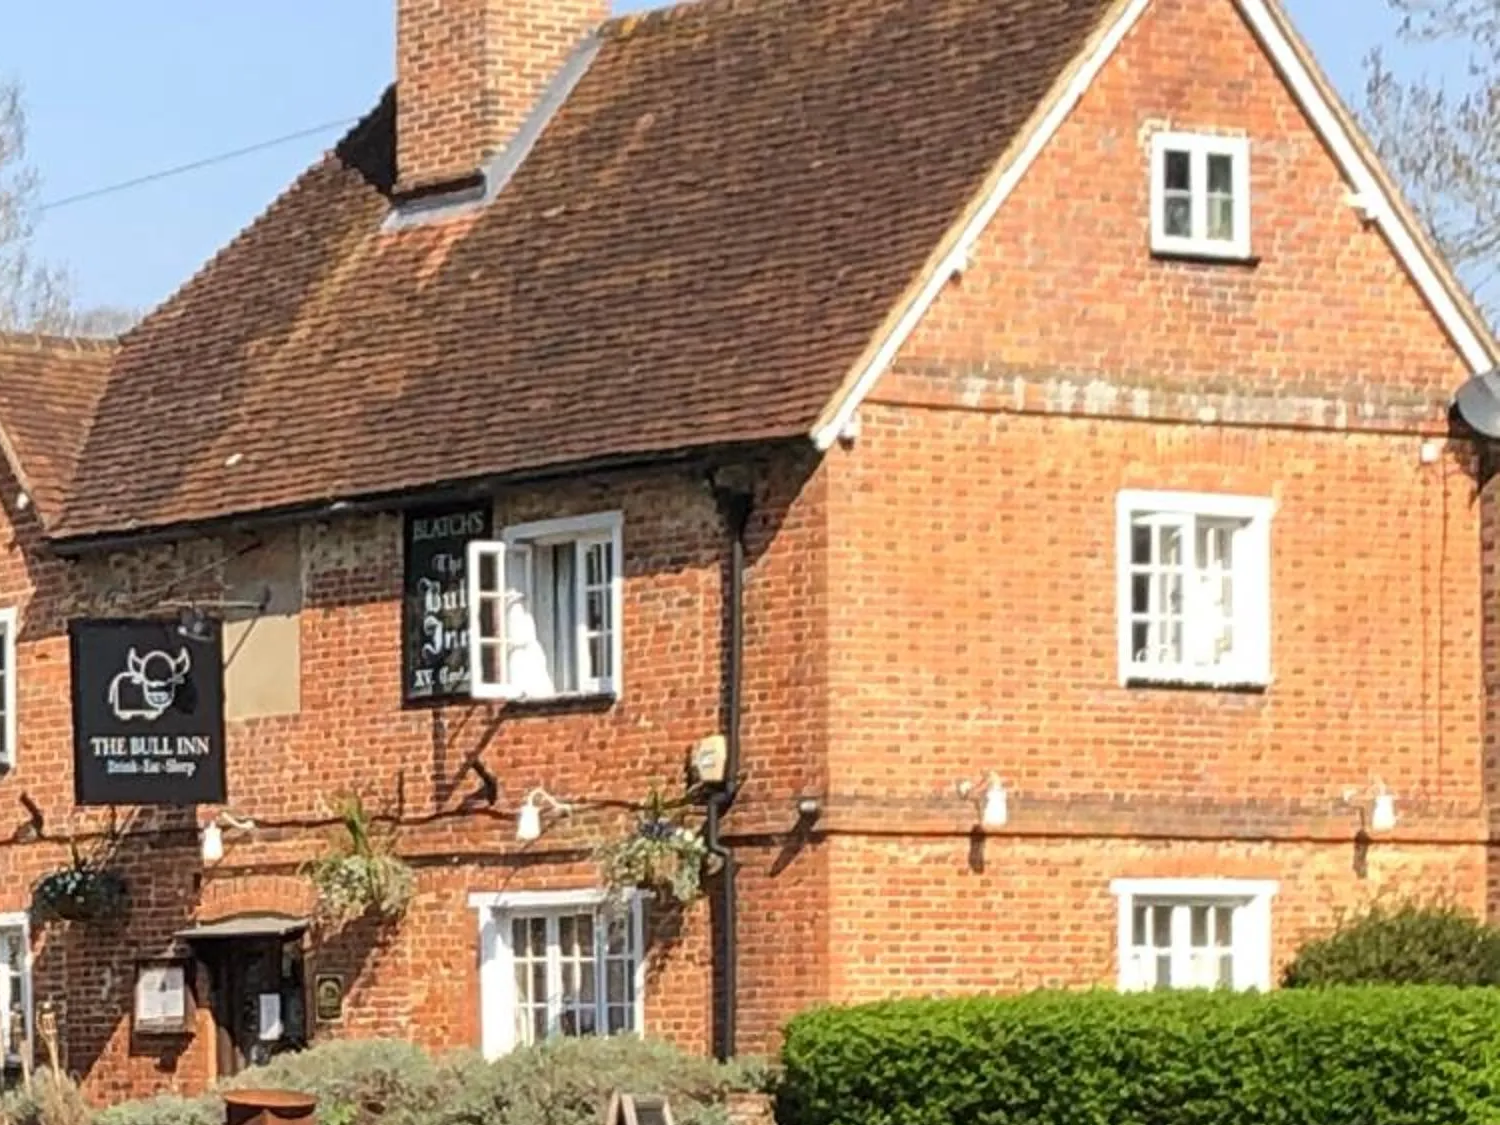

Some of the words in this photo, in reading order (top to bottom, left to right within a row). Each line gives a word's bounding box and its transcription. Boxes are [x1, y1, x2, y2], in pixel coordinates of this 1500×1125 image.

[417, 577, 467, 613] Bul
[90, 736, 128, 756] THE
[129, 736, 174, 755] BULL
[176, 736, 211, 755] INN
